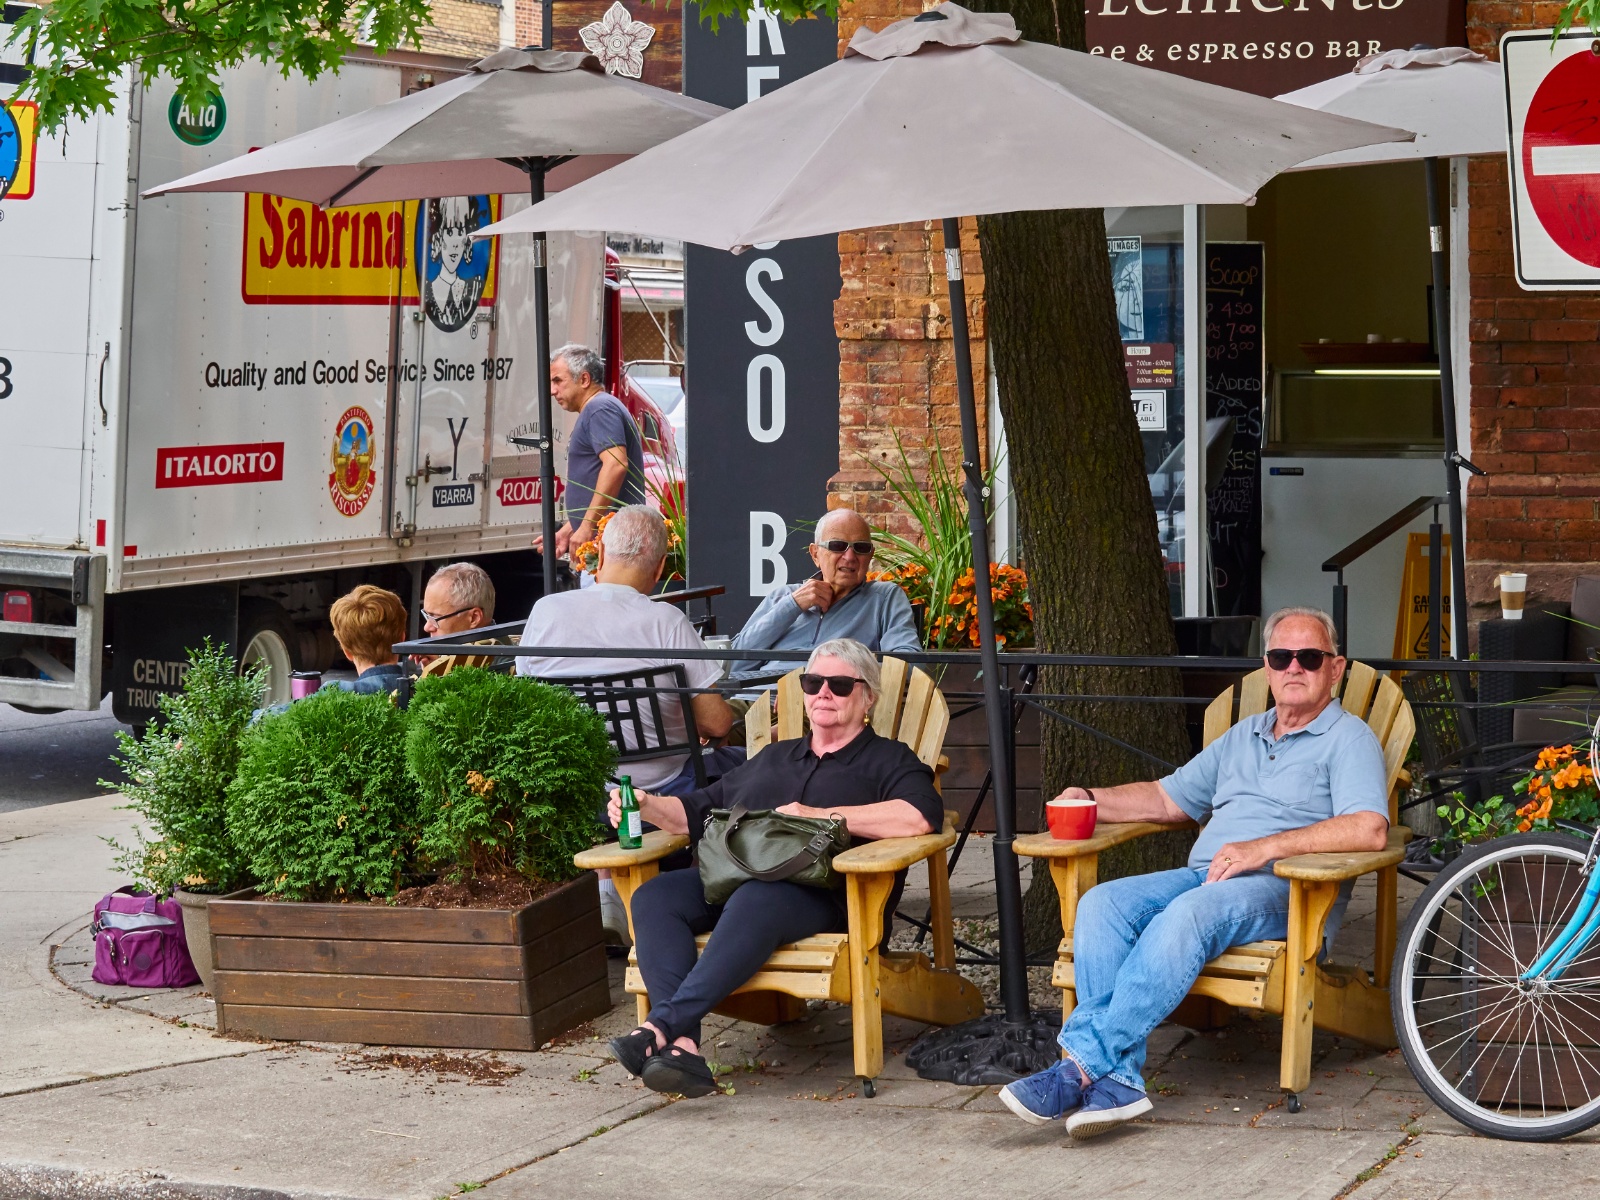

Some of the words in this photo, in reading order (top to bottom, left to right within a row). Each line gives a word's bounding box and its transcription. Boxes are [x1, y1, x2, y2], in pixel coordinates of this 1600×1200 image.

[1136, 44, 1154, 62] &
[259, 193, 407, 270] Sabrina
[634, 239, 664, 254] Market
[1113, 241, 1139, 250] IMAGES
[205, 361, 268, 392] Quality
[273, 360, 307, 386] and
[313, 359, 359, 385] Good
[365, 358, 428, 384] Service
[433, 357, 475, 382] Since
[481, 357, 514, 382] 1987
[446, 417, 469, 481] Y
[165, 451, 276, 479] ITALORTO
[331, 482, 373, 515] RISCOSSA
[434, 487, 473, 505] YBARRA
[127, 687, 168, 709] TRUC
